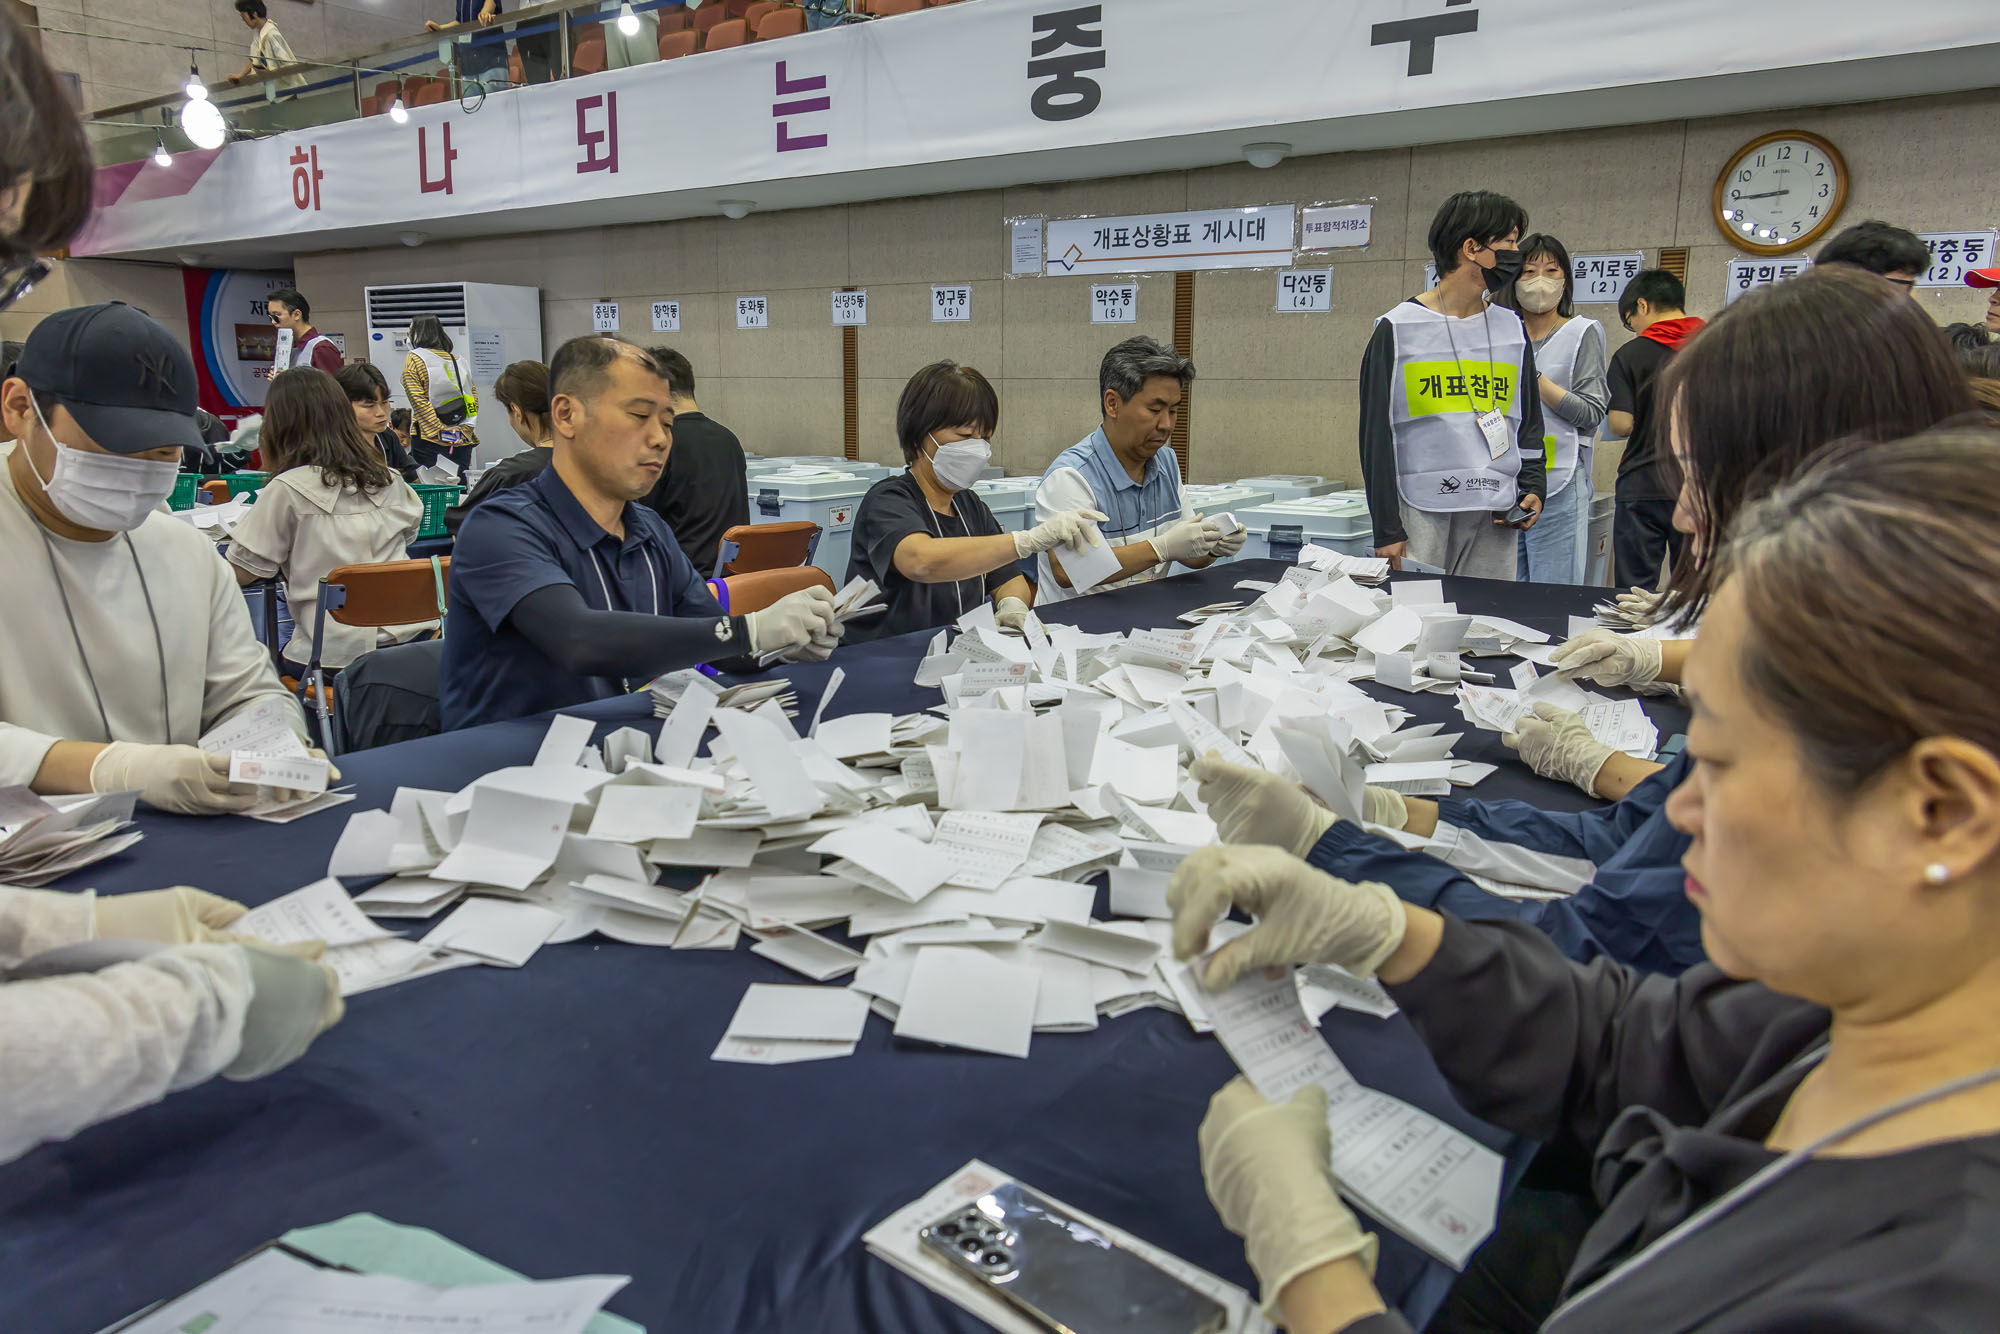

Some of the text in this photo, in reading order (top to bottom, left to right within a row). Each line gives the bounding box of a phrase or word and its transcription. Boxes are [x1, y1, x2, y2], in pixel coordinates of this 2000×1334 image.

[1777, 146, 1791, 160] 12
[1804, 150, 1809, 163] 1
[1756, 155, 1766, 167] 11
[1815, 162, 1825, 176] 2
[1738, 170, 1752, 182] 10
[1731, 189, 1741, 201] 9
[1818, 183, 1829, 198] 3
[1733, 209, 1744, 222] 8
[1808, 205, 1818, 218] 4
[1305, 218, 1368, 234] 투표함적치장소
[1768, 226, 1779, 239] 6
[1791, 221, 1801, 233] 5
[1092, 217, 1267, 251] 개표상황표 게시대
[1574, 260, 1638, 278] 을지로동
[1928, 266, 1962, 281] (2)
[1283, 274, 1326, 294] 다산동
[1591, 281, 1616, 294] (2)
[833, 294, 865, 309] 신당5동
[936, 290, 967, 306] 청구동
[1095, 289, 1133, 307] 약수동
[1293, 296, 1314, 308] (4)
[595, 305, 617, 319] 중림동
[654, 304, 678, 319] 황학동
[738, 300, 765, 315] 동화동
[842, 309, 856, 319] (3)
[943, 308, 959, 318] (5)
[1105, 308, 1122, 319] (5)
[601, 320, 612, 329] (3)
[660, 320, 672, 329] (3)
[746, 316, 759, 325] (4)
[1419, 374, 1510, 402] 개표참관
